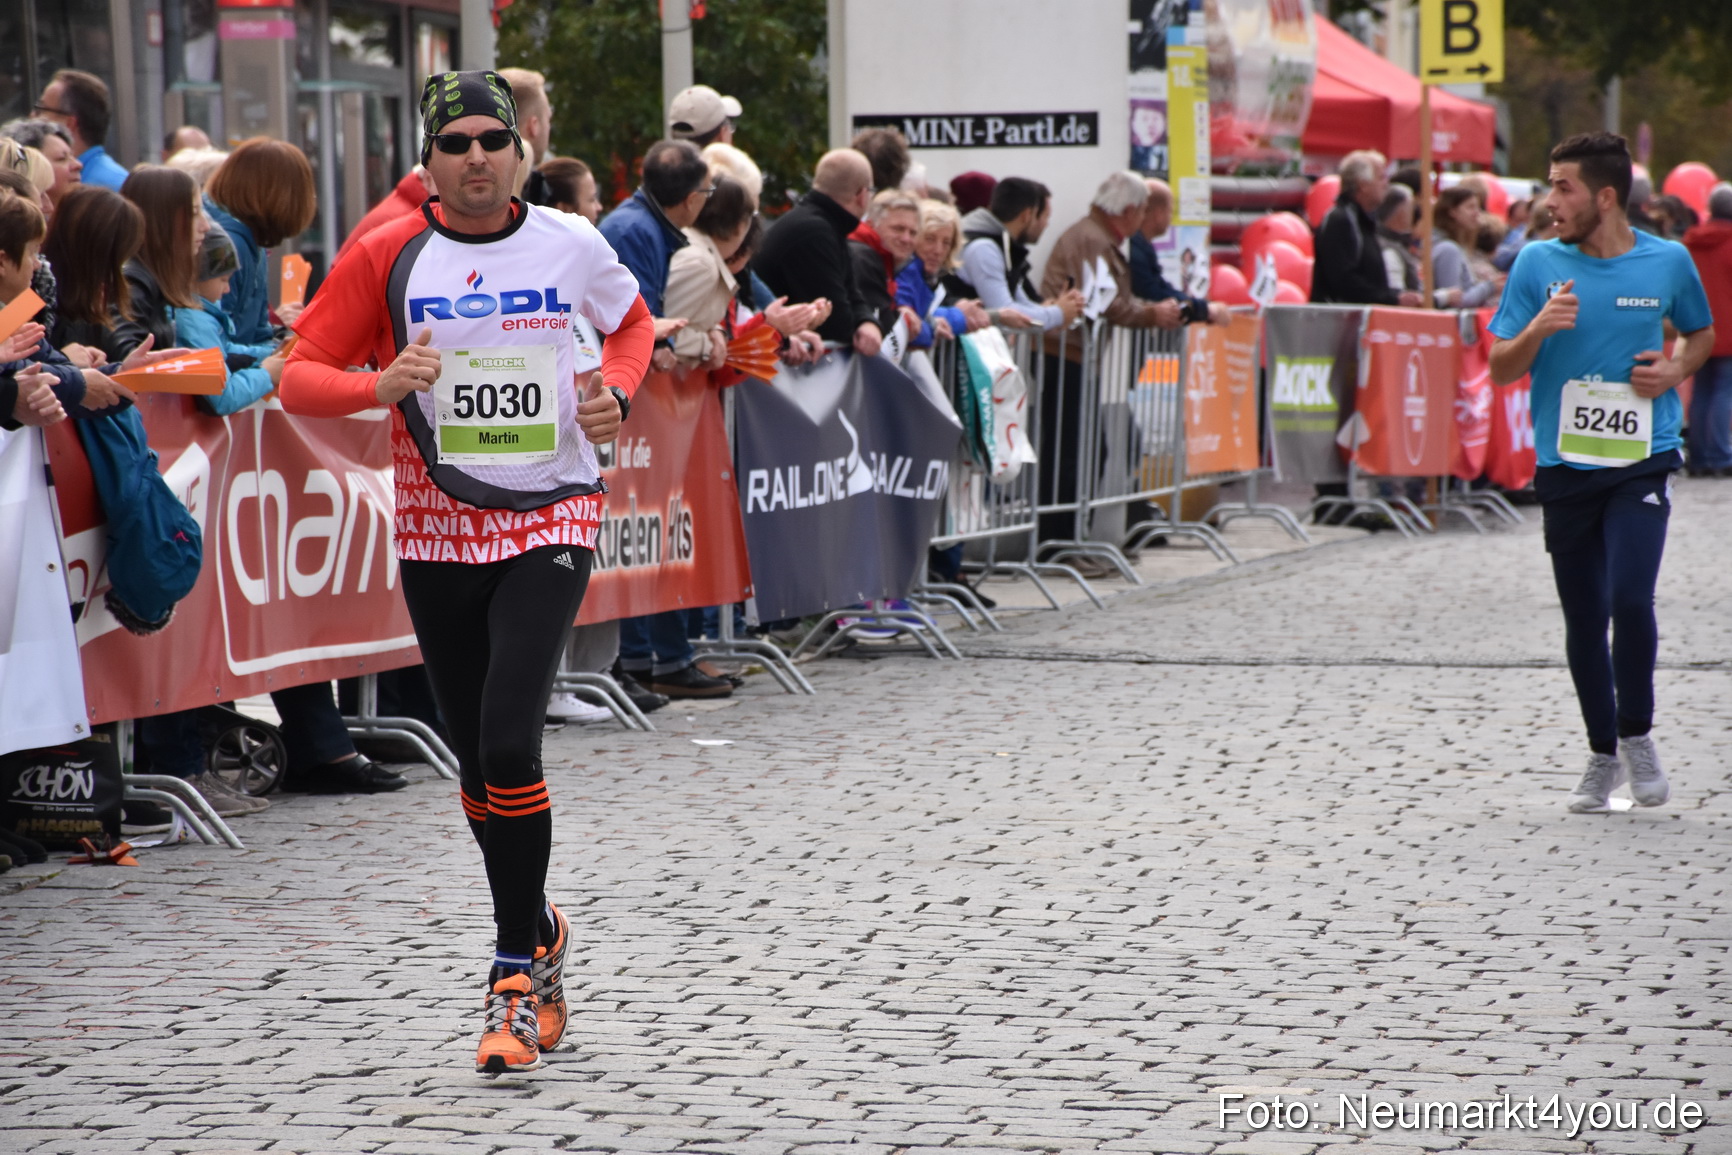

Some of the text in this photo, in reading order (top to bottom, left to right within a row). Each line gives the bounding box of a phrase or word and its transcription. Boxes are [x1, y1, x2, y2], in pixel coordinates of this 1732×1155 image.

[1444, 0, 1481, 55] B
[1616, 297, 1659, 307] BOCK
[502, 312, 568, 331] energie
[482, 358, 525, 368] BOCK
[1274, 362, 1332, 405] BOCK
[453, 382, 541, 419] 5030
[1574, 407, 1639, 435] 5246
[479, 431, 519, 445] Martin
[747, 457, 845, 513] RAIL.ONE
[553, 557, 575, 571] adidas
